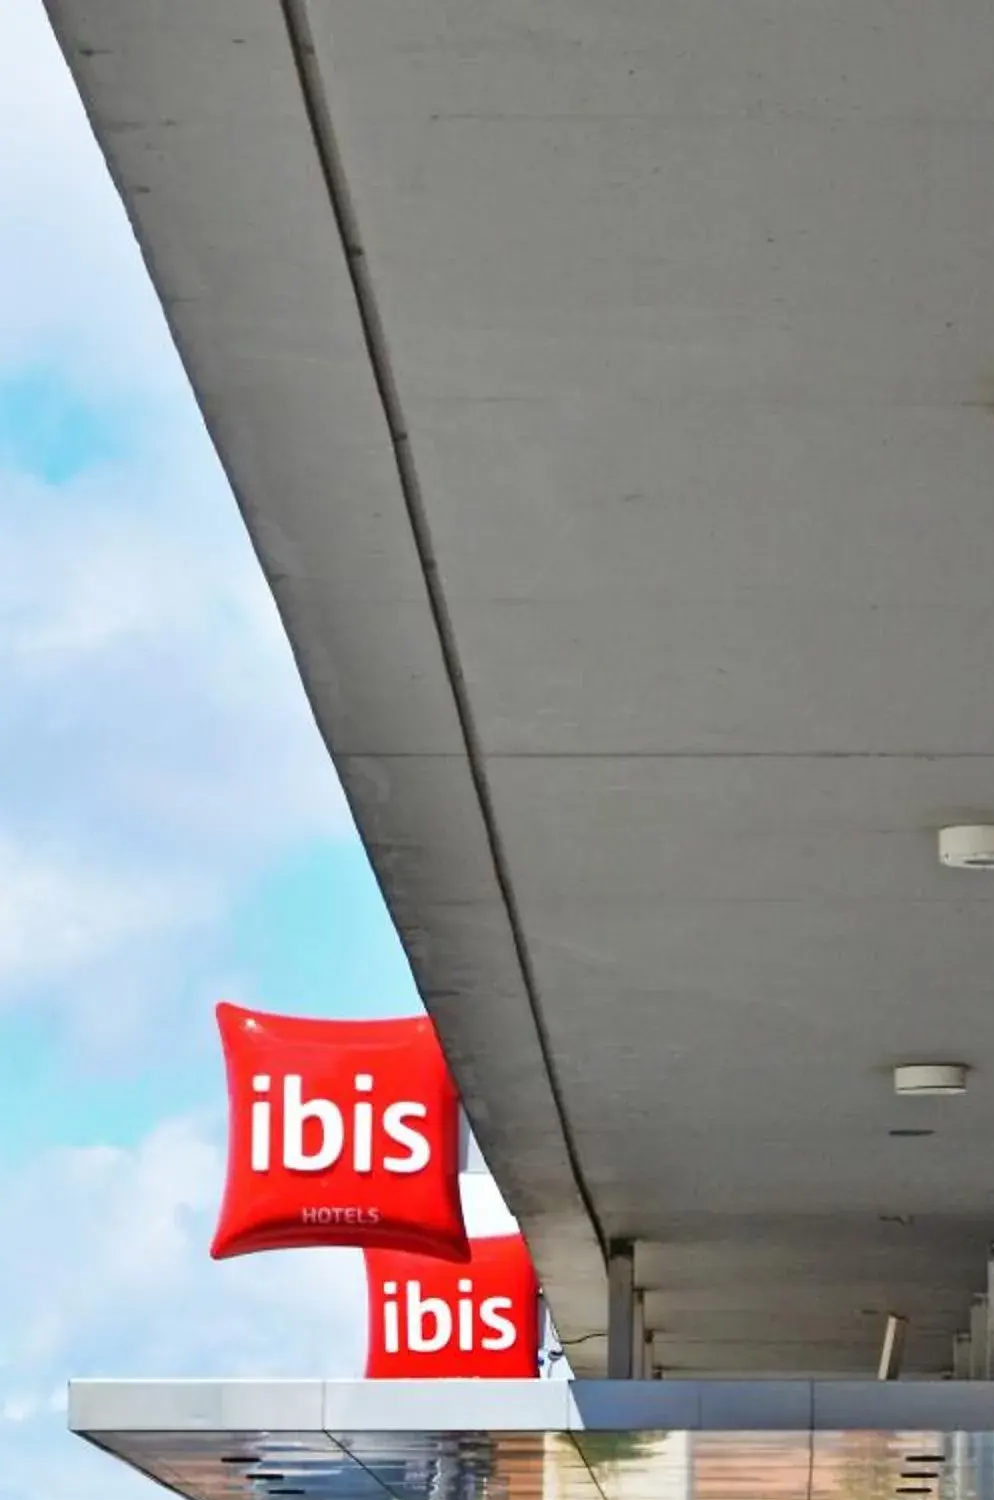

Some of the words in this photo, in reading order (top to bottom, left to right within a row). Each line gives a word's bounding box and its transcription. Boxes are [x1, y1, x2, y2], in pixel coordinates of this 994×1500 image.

[251, 1074, 431, 1173] ibis
[302, 1206, 380, 1224] HOTELS
[383, 1279, 517, 1353] ibis
